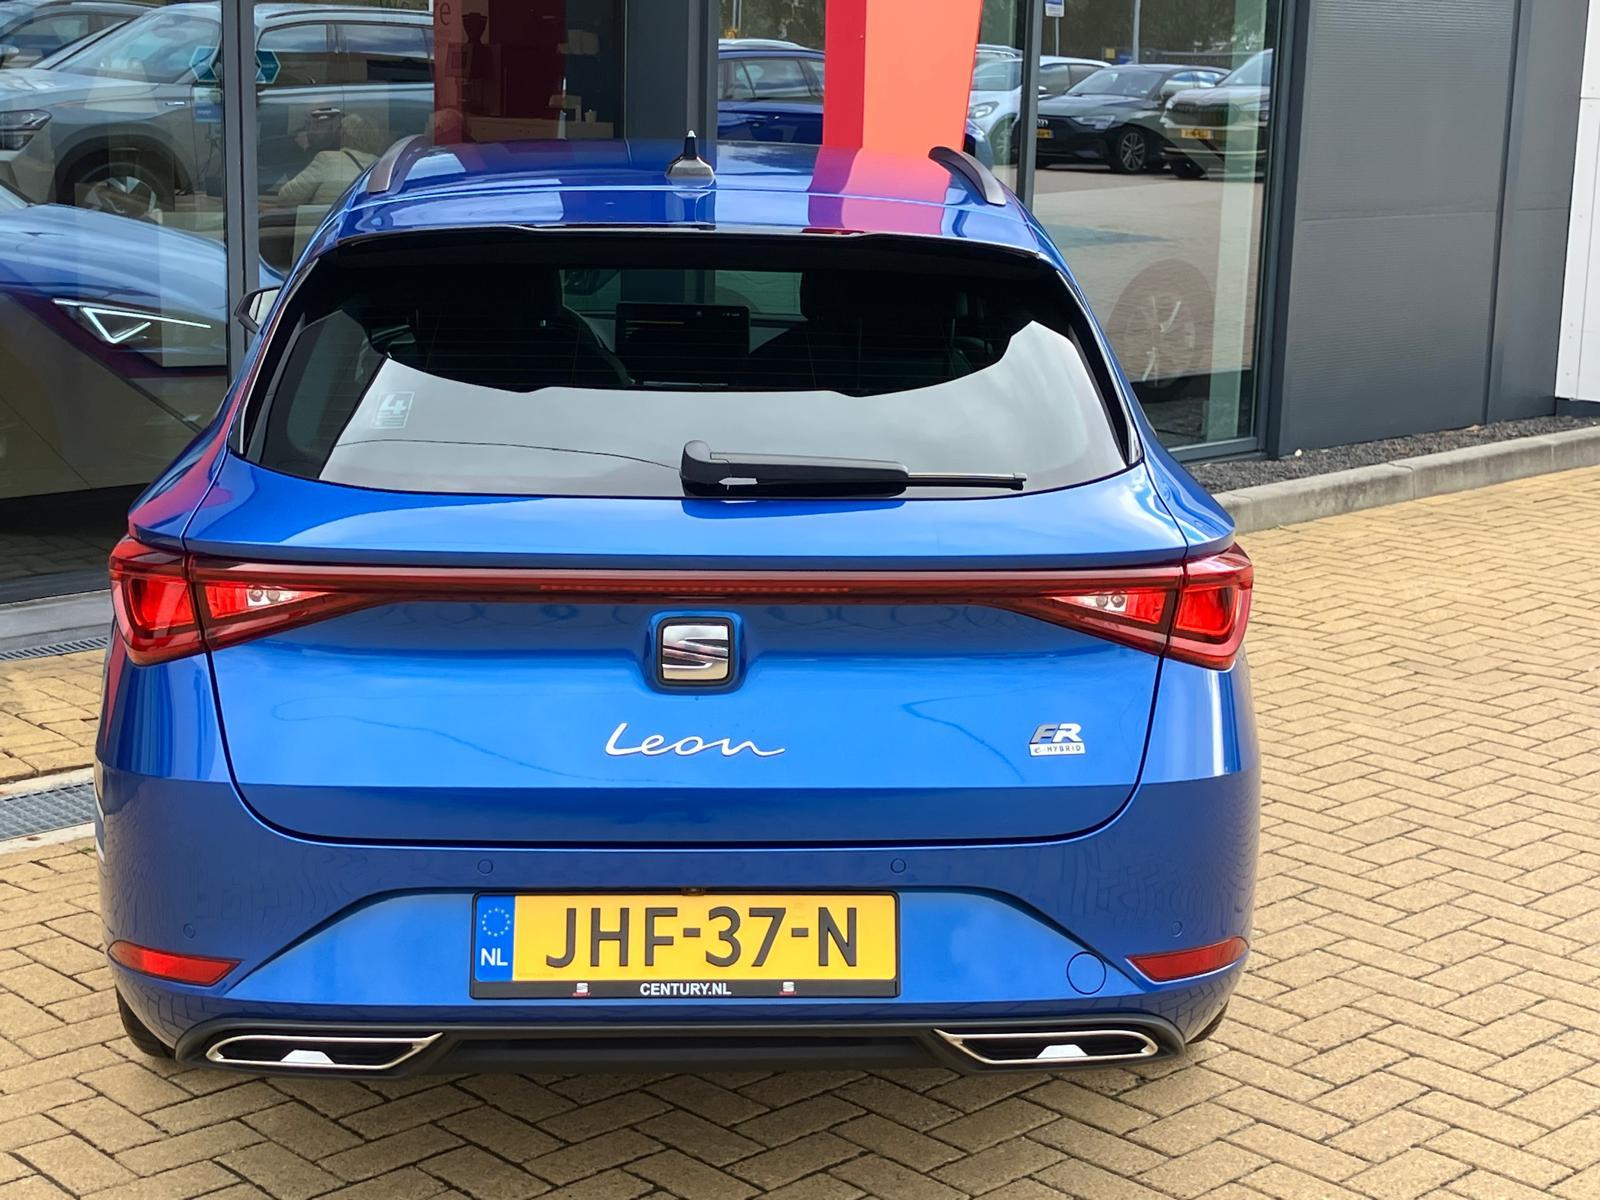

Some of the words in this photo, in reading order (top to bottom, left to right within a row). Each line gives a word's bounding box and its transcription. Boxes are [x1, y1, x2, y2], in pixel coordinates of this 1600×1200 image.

[605, 722, 785, 756] Leon
[546, 906, 857, 968] JHF-37-N
[481, 948, 508, 966] NL
[639, 982, 732, 996] CENTURY.NL
